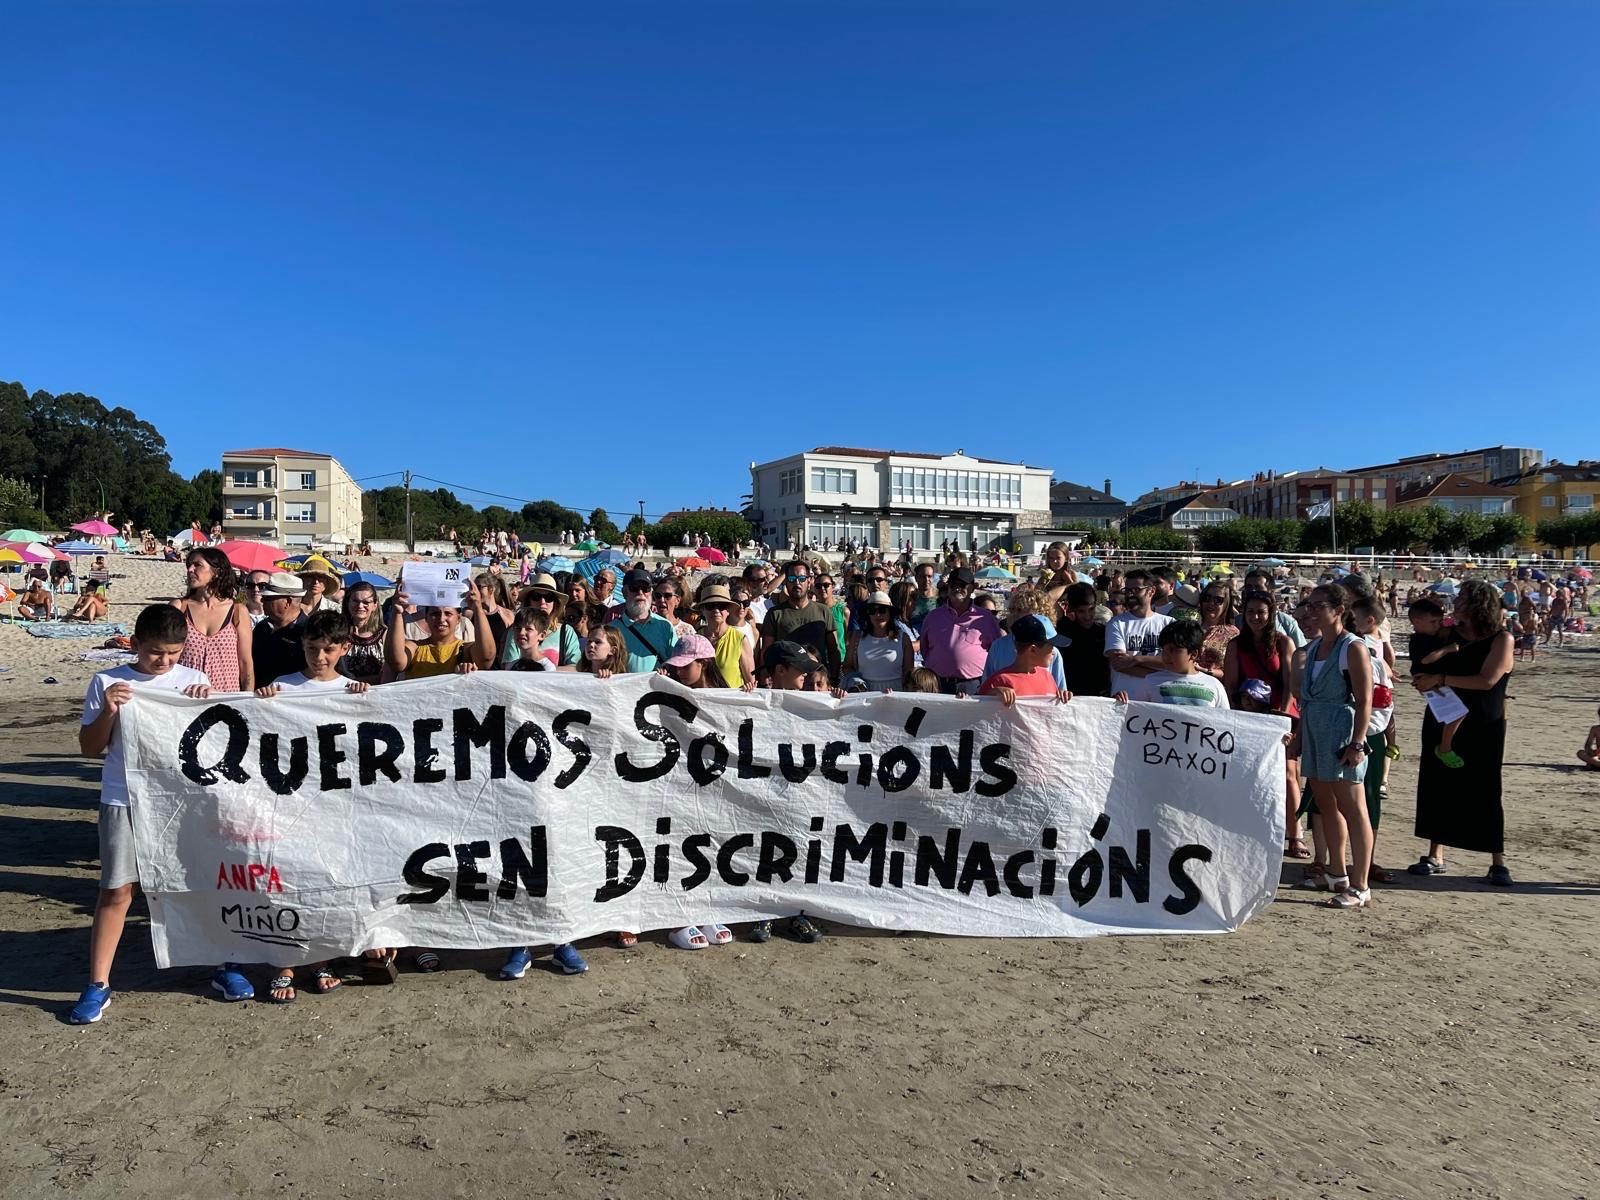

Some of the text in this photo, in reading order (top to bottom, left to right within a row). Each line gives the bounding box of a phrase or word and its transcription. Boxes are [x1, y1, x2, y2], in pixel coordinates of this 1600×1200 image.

[179, 703, 592, 795] QUEREMOS
[1126, 715, 1235, 755] CASTRO
[1143, 742, 1227, 780] BAXOI
[216, 861, 283, 893] ANPA
[397, 826, 548, 905] SEN
